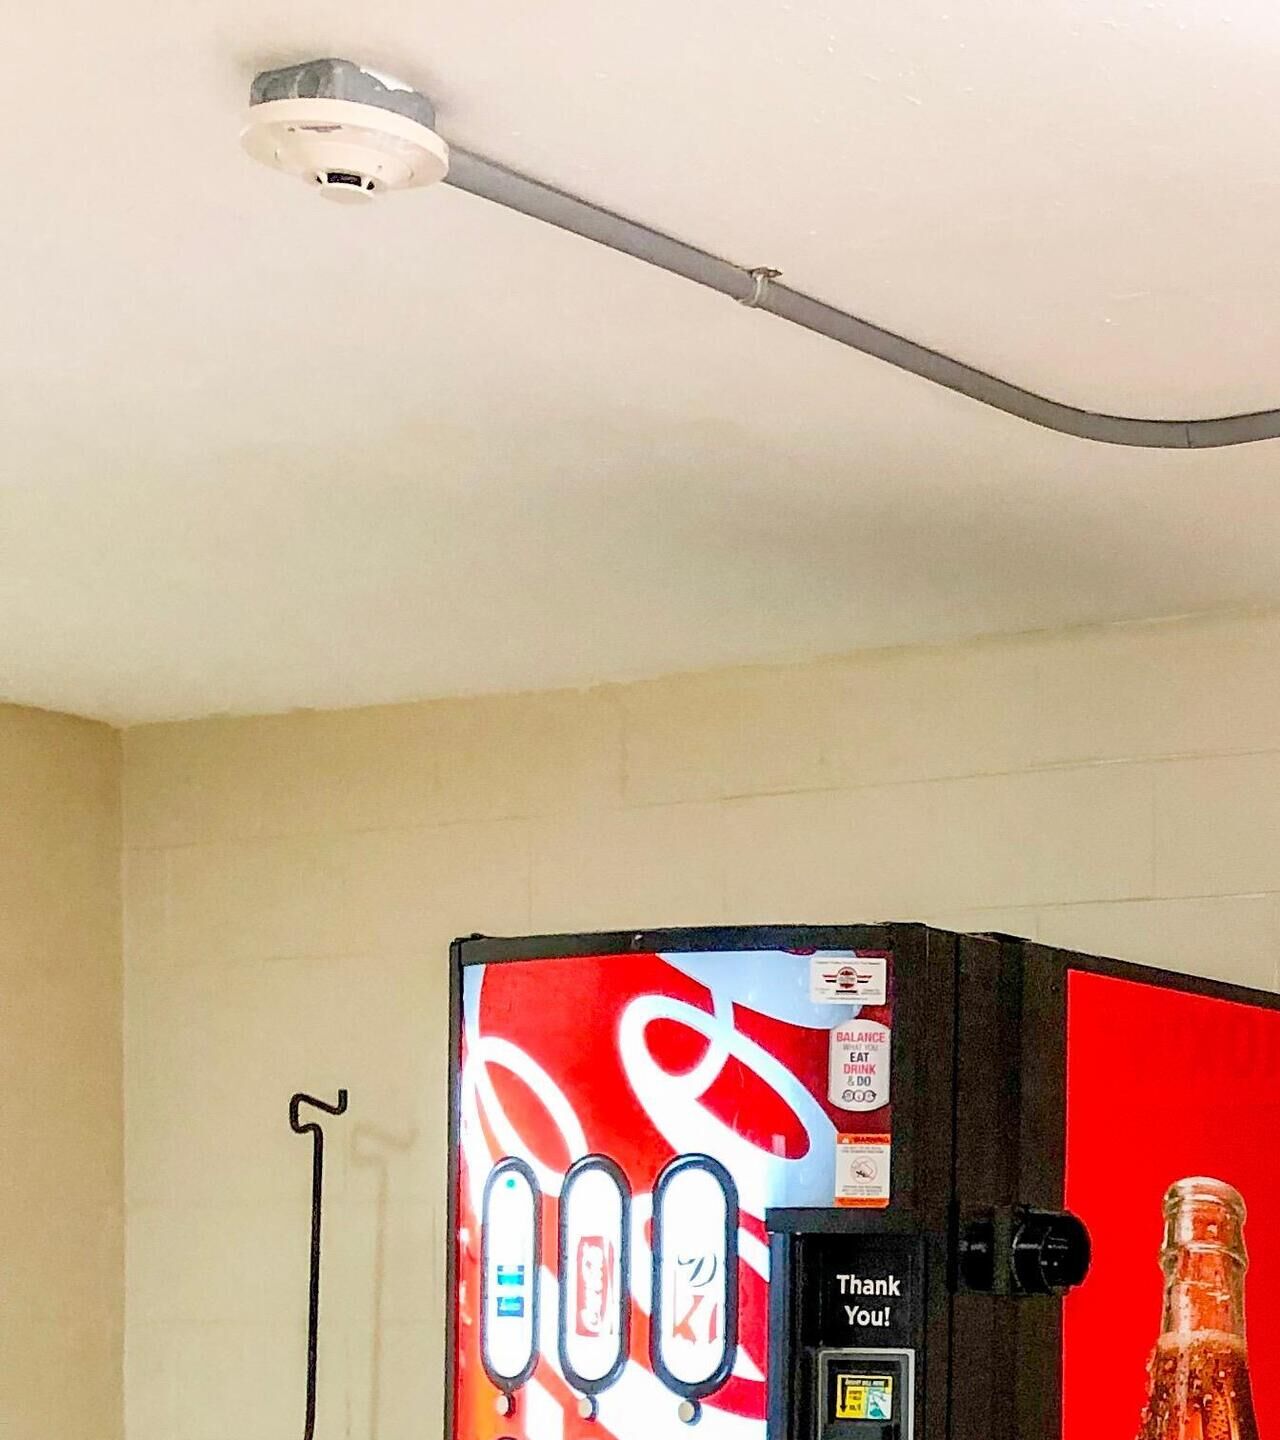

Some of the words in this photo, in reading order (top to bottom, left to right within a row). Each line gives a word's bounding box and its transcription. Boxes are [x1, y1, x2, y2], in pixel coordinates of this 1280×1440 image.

[836, 1031, 886, 1043] BALANCE
[850, 1052, 869, 1062] EAT
[843, 1063, 876, 1075] DRINK
[857, 1076, 871, 1086] DO
[836, 1274, 901, 1297] Thank
[844, 1305, 891, 1328] You!
